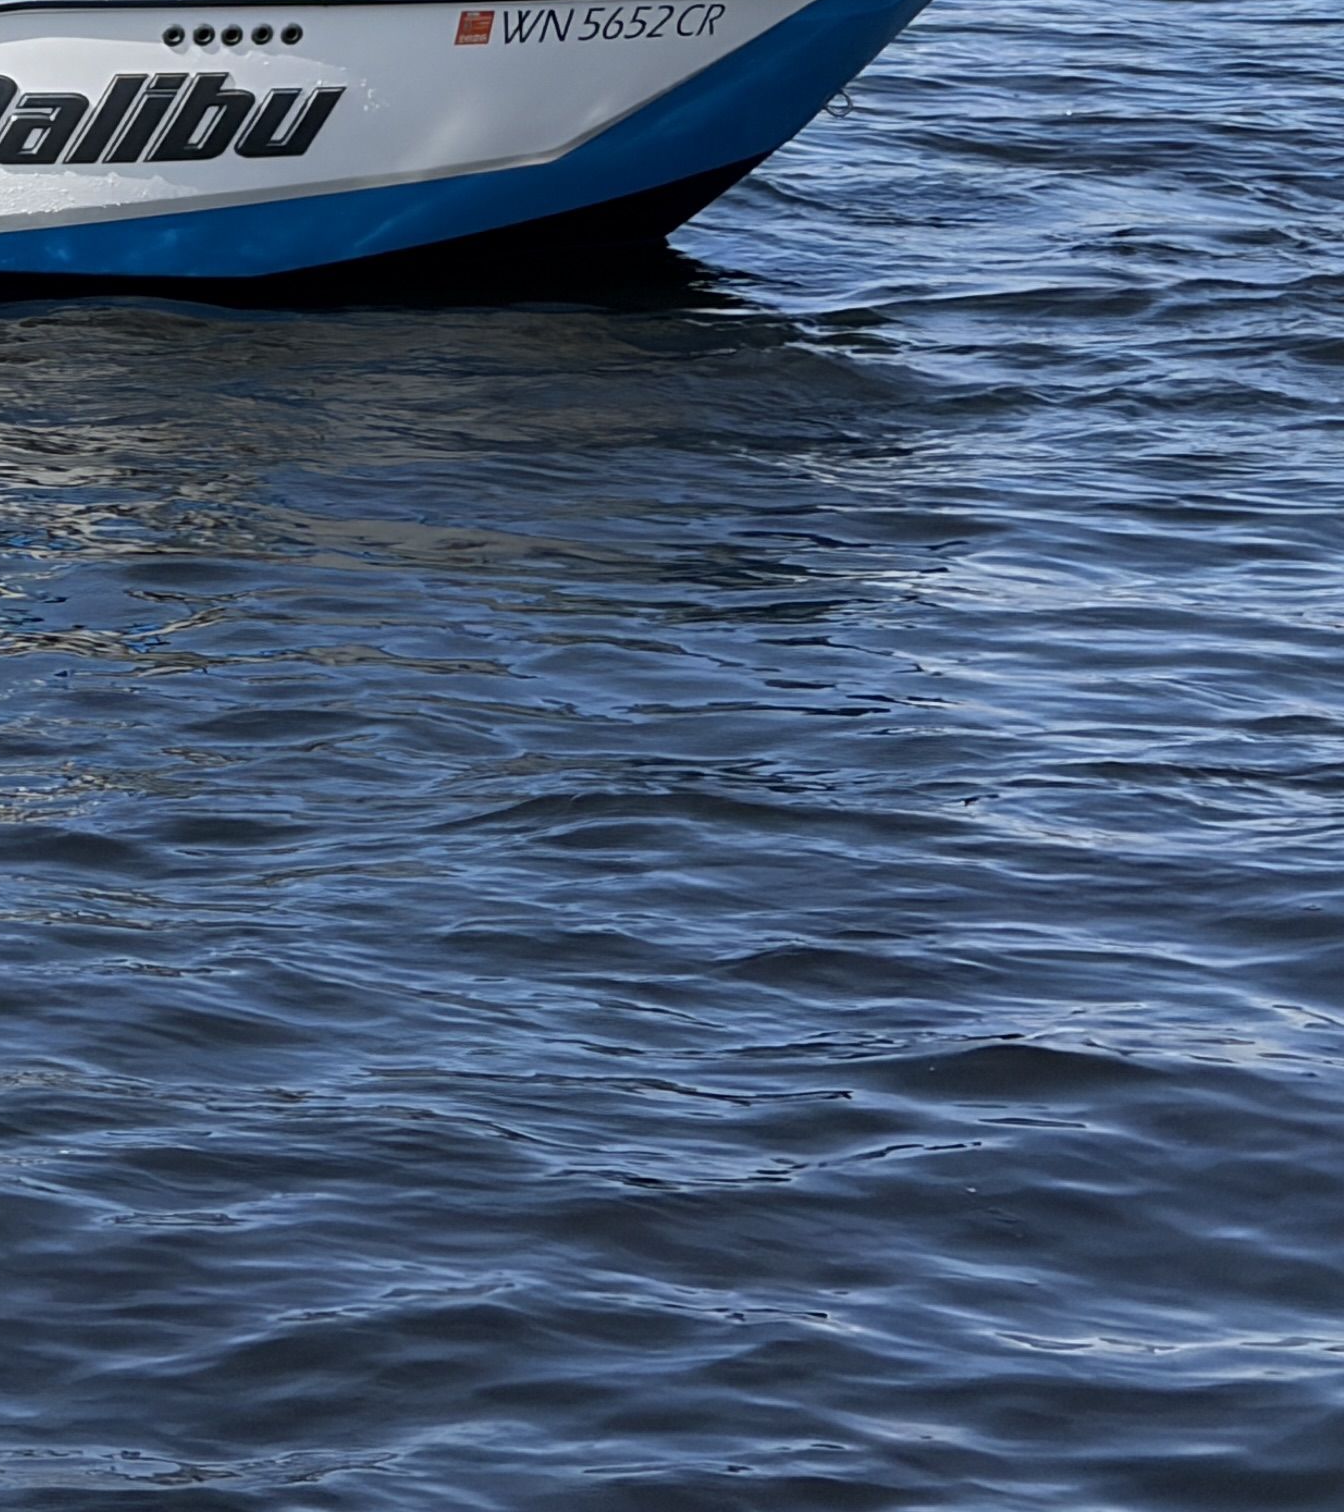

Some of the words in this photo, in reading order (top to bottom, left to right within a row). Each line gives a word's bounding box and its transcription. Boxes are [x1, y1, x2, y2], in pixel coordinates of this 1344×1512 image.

[504, 8, 575, 44] WN
[578, 5, 674, 41] 5652
[676, 3, 726, 37] CR
